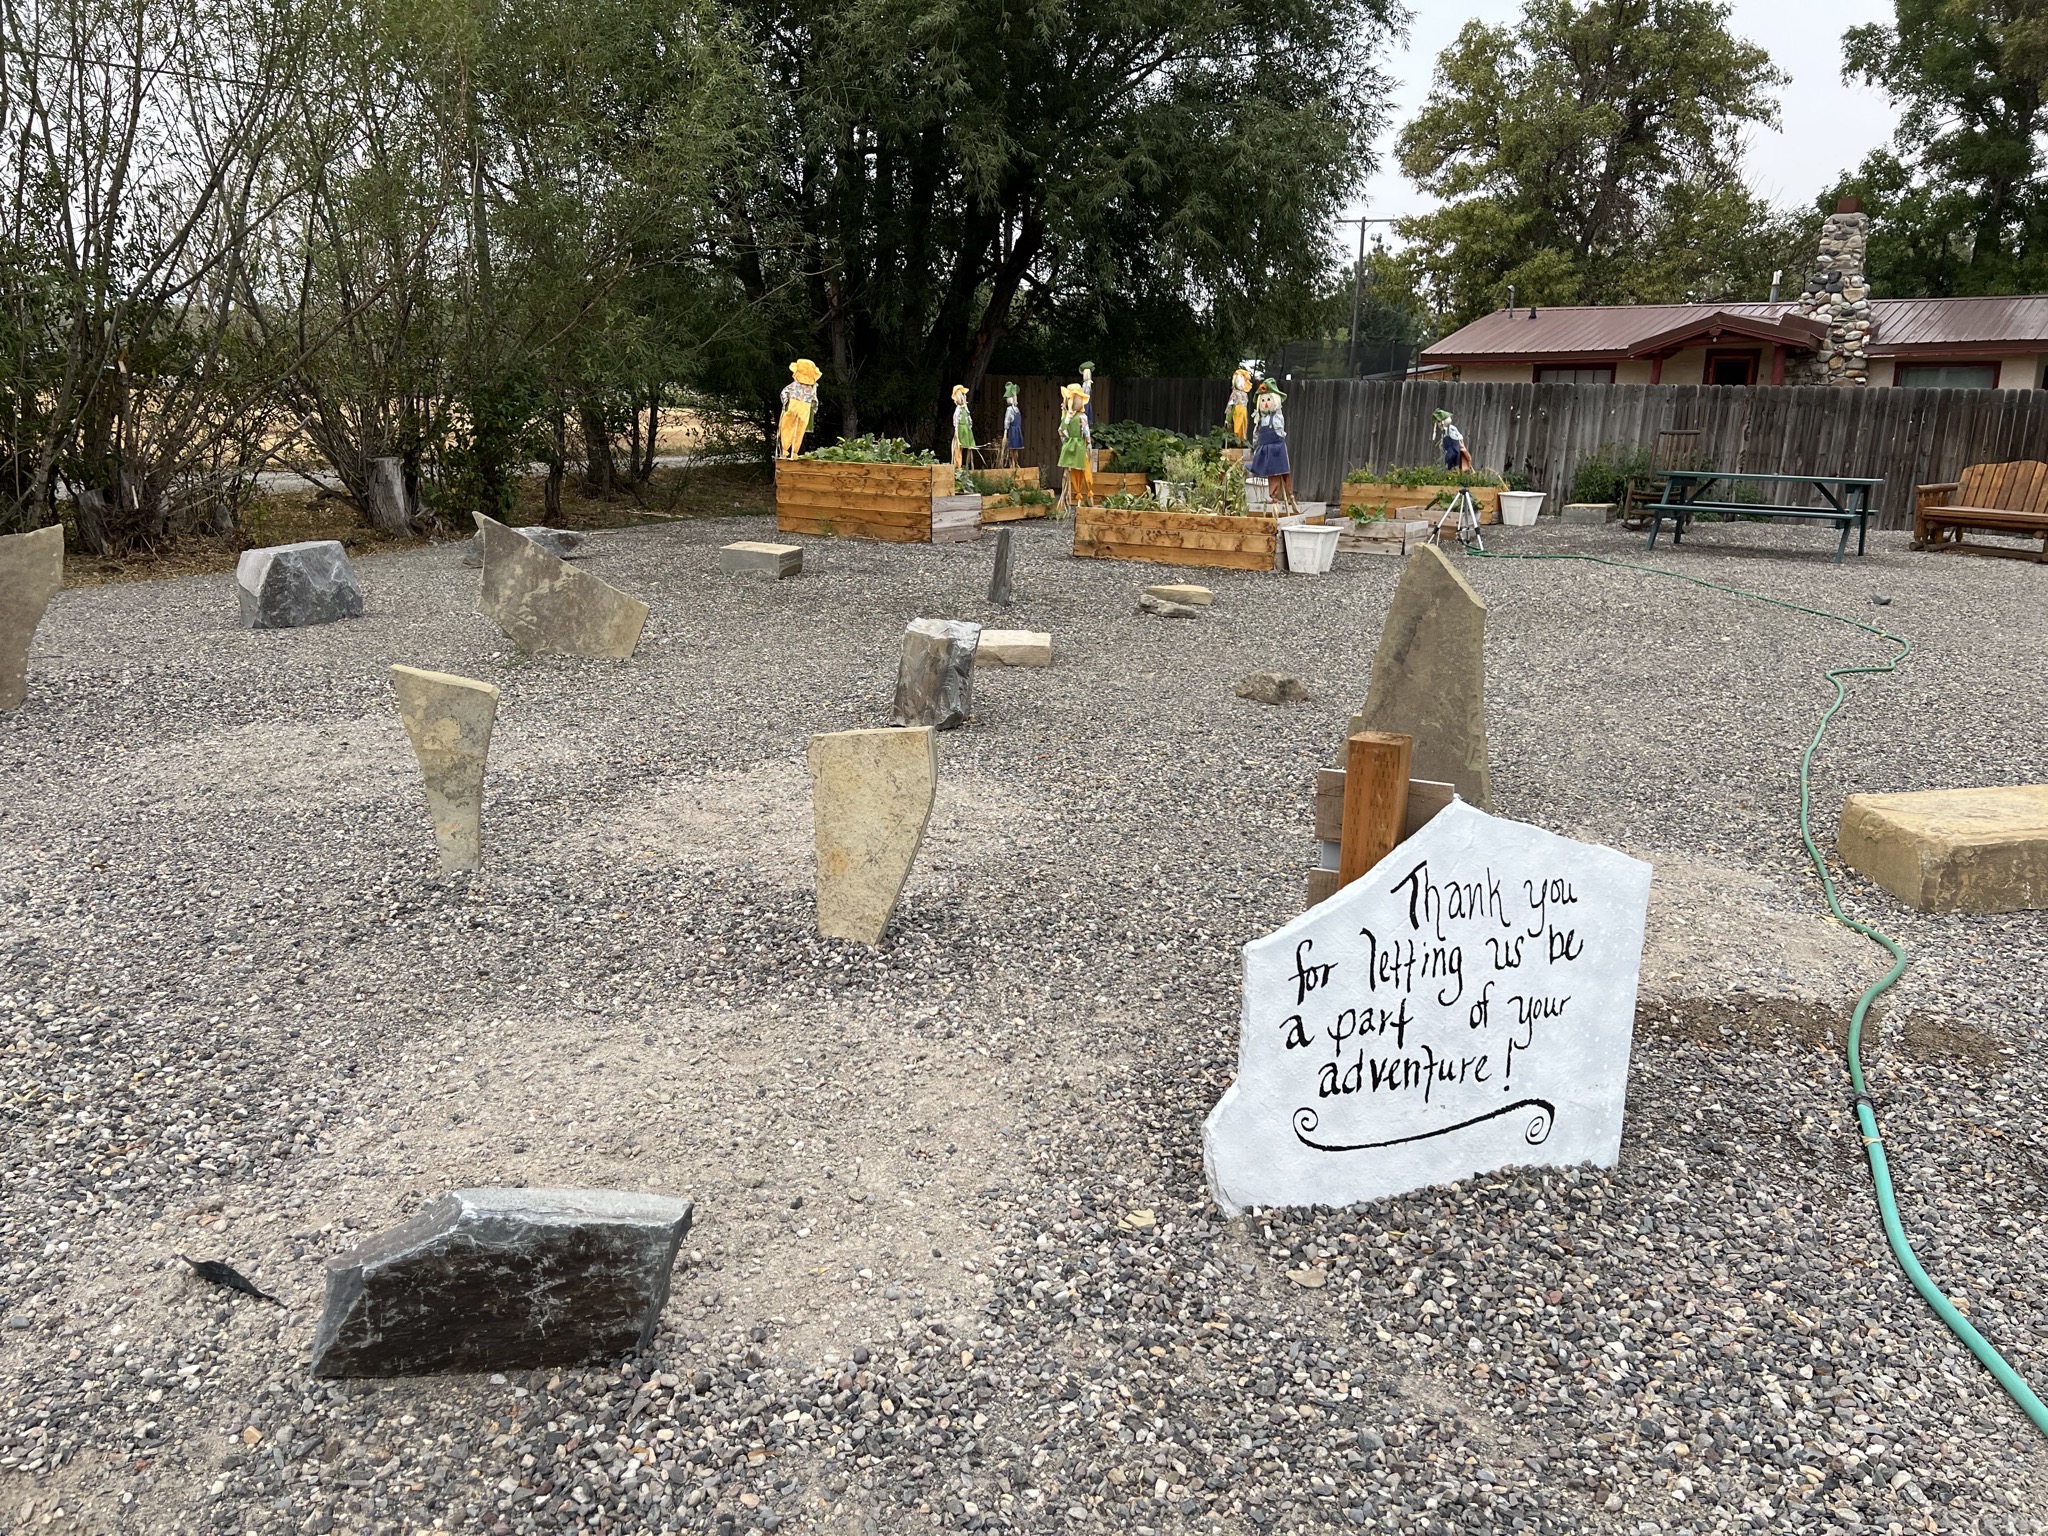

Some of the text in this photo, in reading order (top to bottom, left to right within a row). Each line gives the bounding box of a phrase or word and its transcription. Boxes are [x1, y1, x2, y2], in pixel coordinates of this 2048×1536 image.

[1391, 860, 1578, 940] Thank you
[1288, 925, 1584, 1006] for letting us be
[1279, 981, 1571, 1056] a part of your
